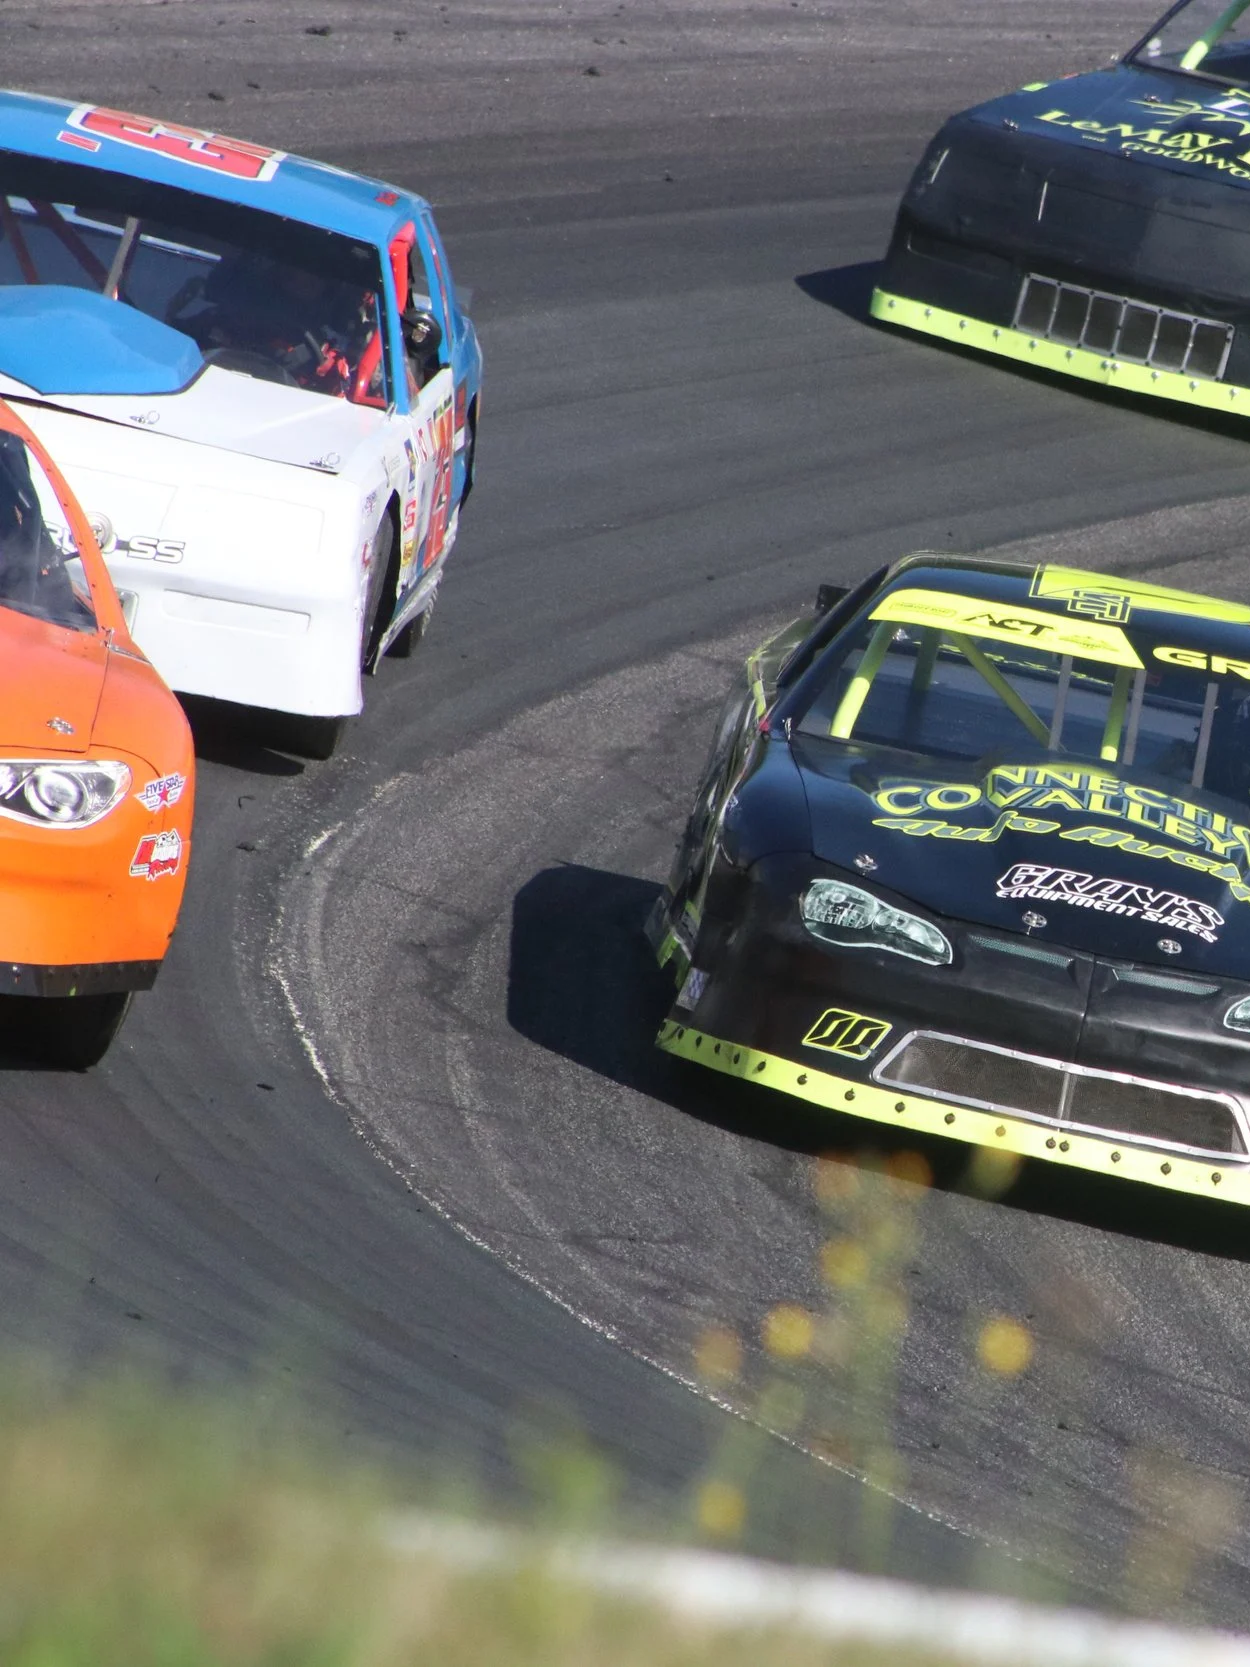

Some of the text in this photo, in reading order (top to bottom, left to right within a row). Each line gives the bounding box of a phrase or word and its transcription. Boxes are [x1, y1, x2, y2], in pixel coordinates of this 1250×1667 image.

[1035, 109, 1234, 153] LeMay
[963, 612, 1056, 636] ACT
[872, 811, 1061, 842] Auto
[988, 786, 1246, 859] VALLEY
[996, 863, 1225, 931] GRAY'S
[996, 887, 1218, 943] EQUIPMENT SALES
[802, 1008, 893, 1061] 00
